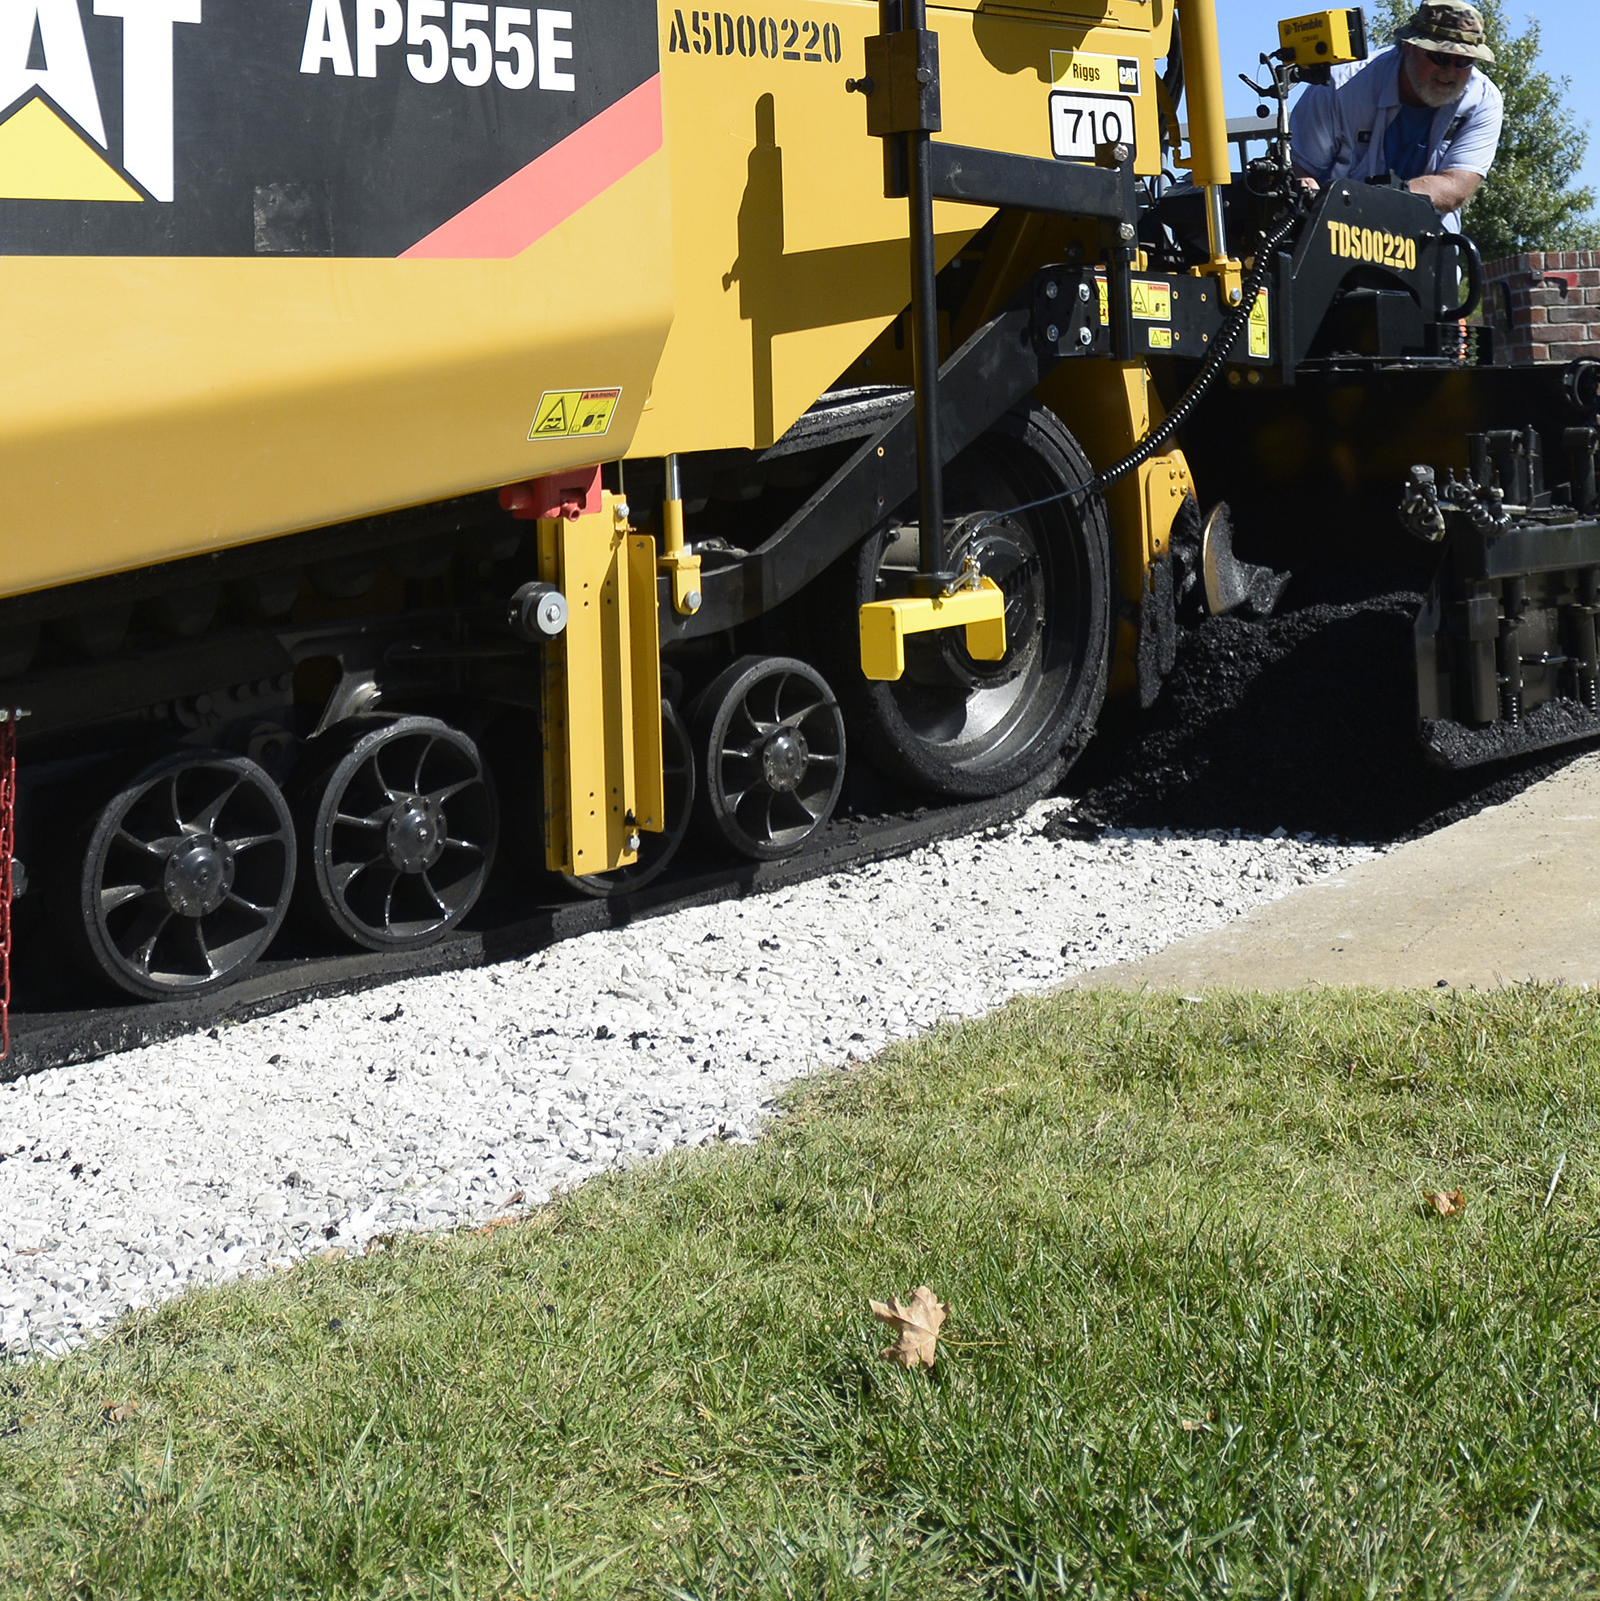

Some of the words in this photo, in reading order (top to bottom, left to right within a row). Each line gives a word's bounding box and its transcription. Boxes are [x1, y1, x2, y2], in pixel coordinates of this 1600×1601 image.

[669, 9, 842, 64] A5D00220
[1292, 18, 1324, 33] Trimble
[1072, 63, 1100, 82] Riggs
[1119, 66, 1137, 86] CAT
[1063, 108, 1122, 145] 710
[1327, 220, 1417, 270] TDS00220
